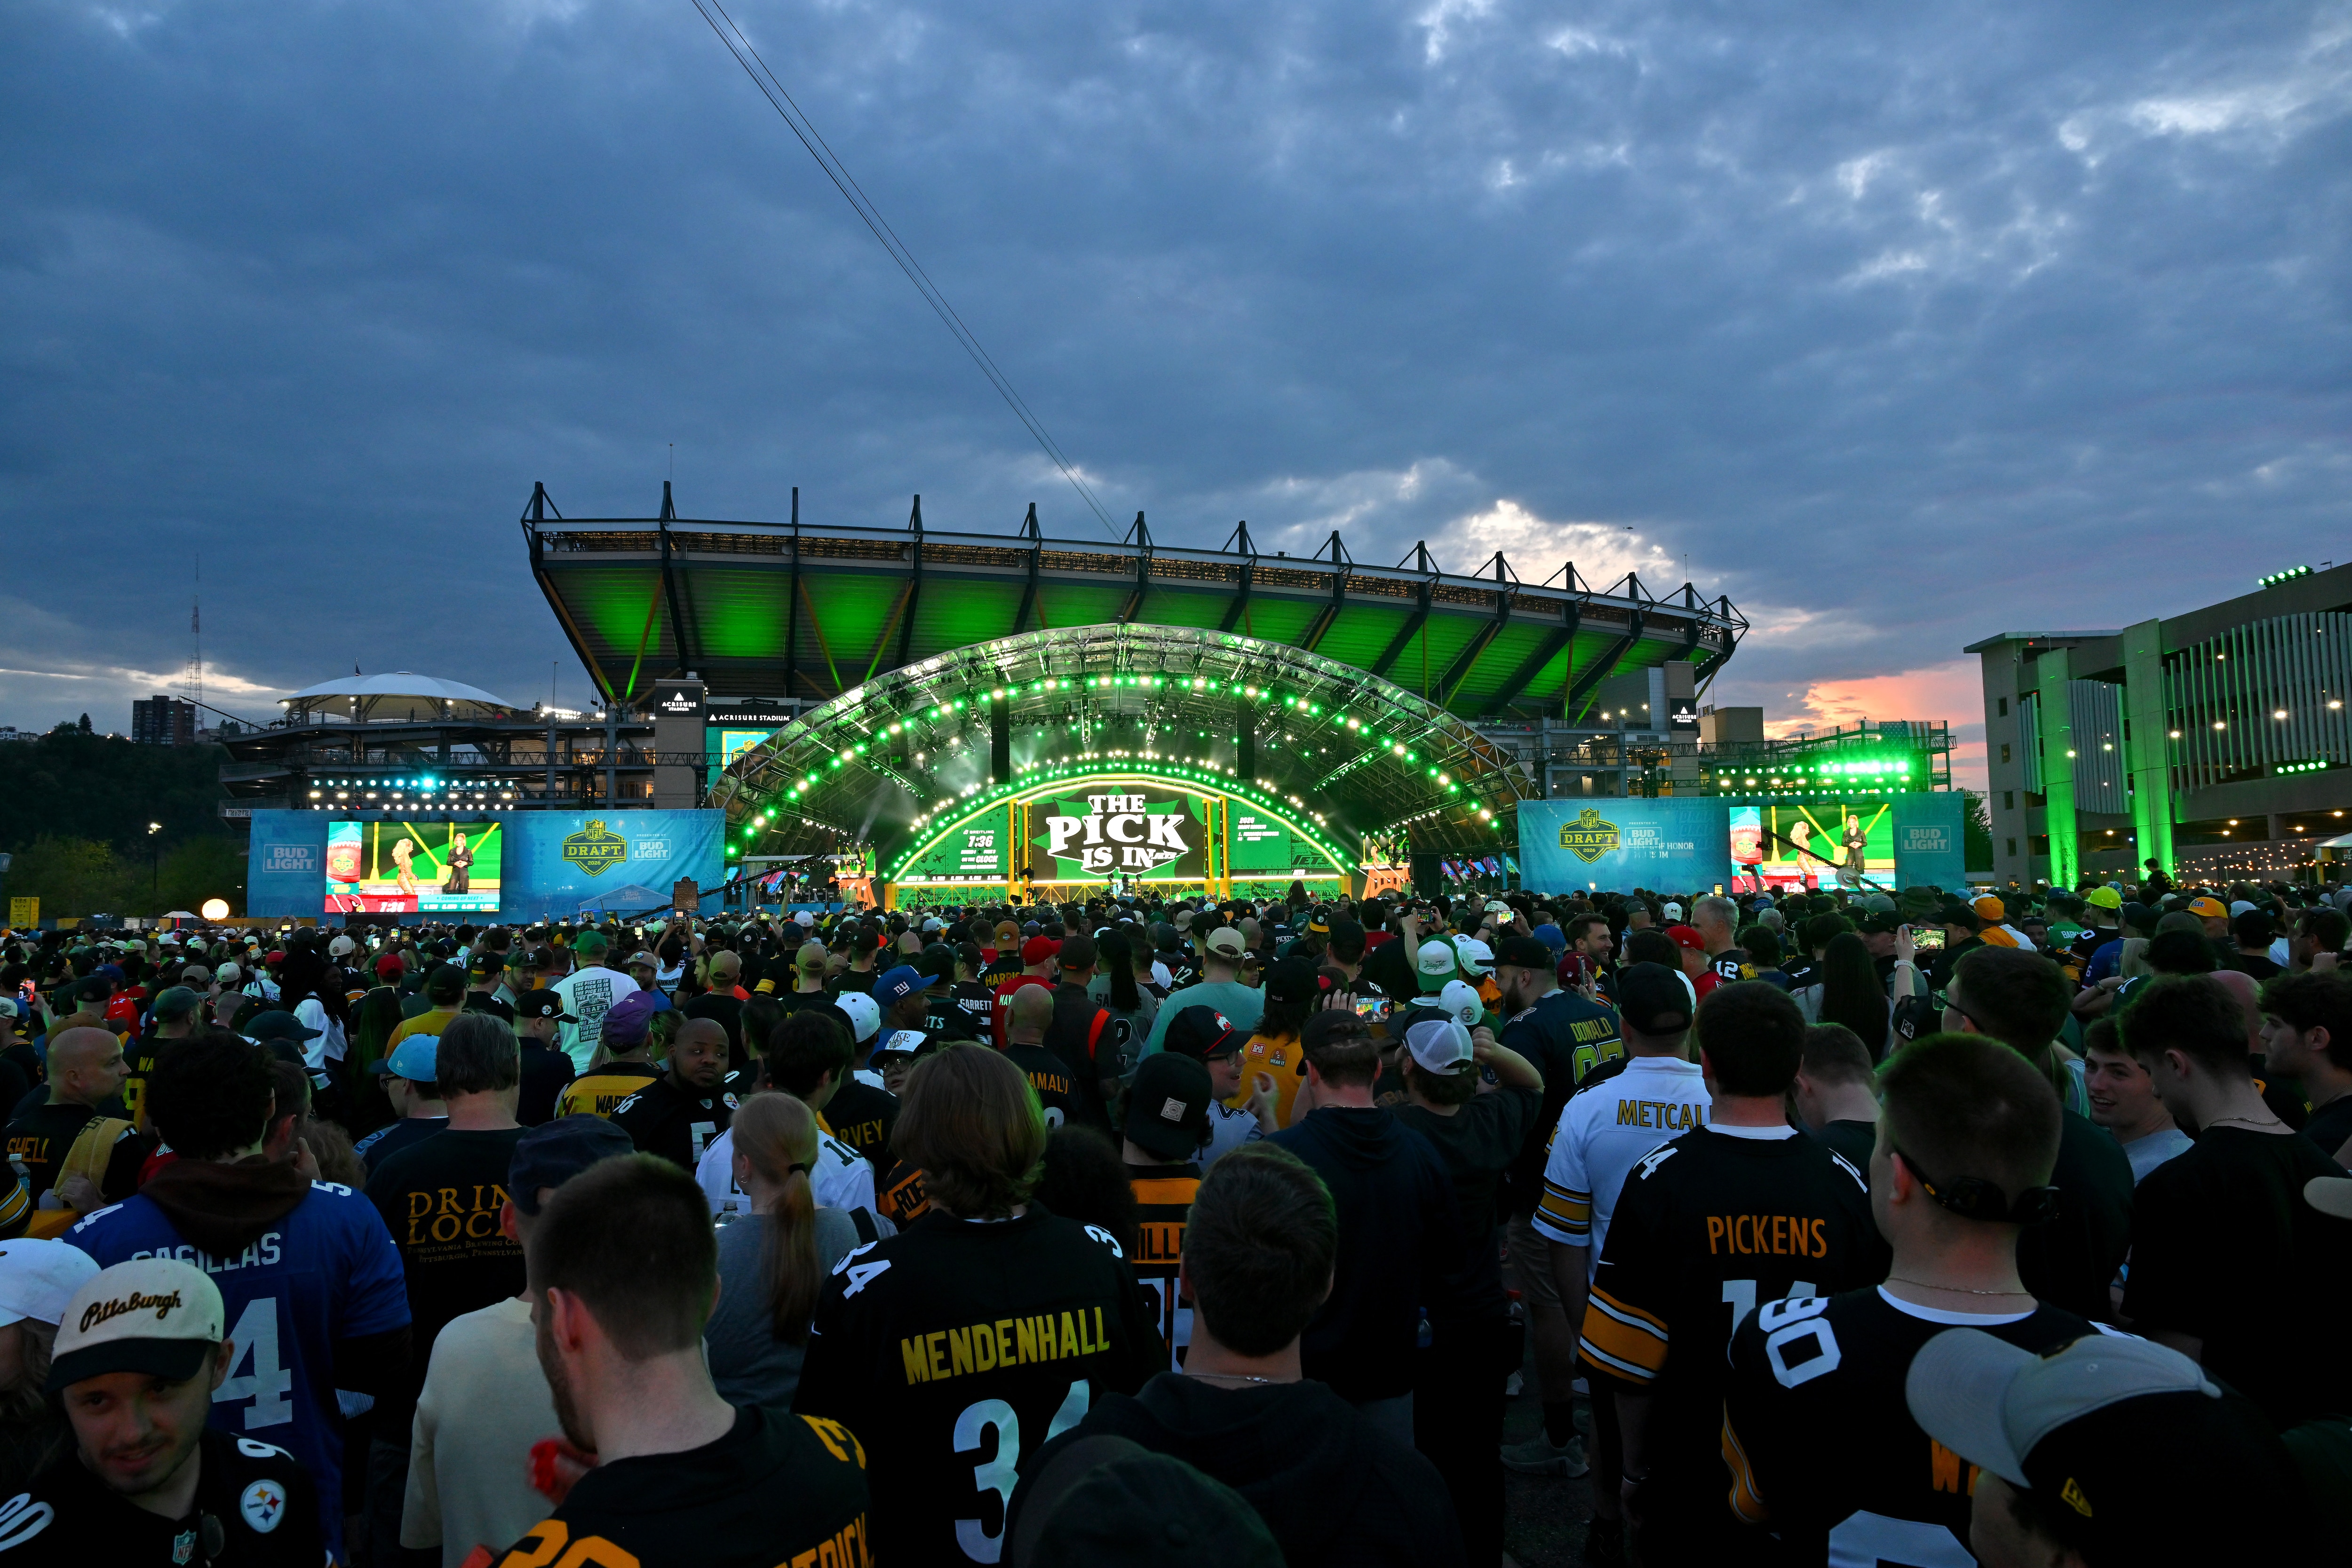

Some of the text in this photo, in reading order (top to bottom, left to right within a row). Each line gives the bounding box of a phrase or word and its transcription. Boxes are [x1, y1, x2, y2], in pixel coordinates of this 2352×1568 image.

[1088, 794, 1146, 813] THE
[1046, 814, 1189, 852] PICK
[1564, 834, 1614, 844] DRAFT
[1910, 829, 1937, 839] BUD
[639, 842, 664, 850] BUD
[968, 836, 993, 847] 7:36
[1628, 837, 1660, 846] LIGHT
[1904, 839, 1947, 850] LIGHT
[274, 848, 308, 858] BUD
[567, 846, 621, 856] DRAFT
[635, 850, 668, 858] LIGHT
[1151, 851, 1177, 860] JETS
[1081, 846, 1156, 869] IS IN
[266, 859, 314, 869] LIGHT
[380, 902, 405, 913] 7:36
[2191, 899, 2205, 908] Pitt
[1715, 960, 1739, 980] 12
[893, 980, 911, 996] ny
[581, 1005, 607, 1014] DRAFT
[960, 998, 993, 1011] GARRETT
[1569, 1017, 1614, 1043] DONALD
[612, 1094, 643, 1114] 56
[1617, 1100, 1712, 1130] METCAL
[406, 1210, 506, 1245] LOC
[1707, 1214, 1828, 1258] PICKENS
[1133, 1227, 1183, 1260] ILL
[79, 1290, 182, 1333] Pittsburgh
[900, 1306, 1111, 1386] MENDENHALL
